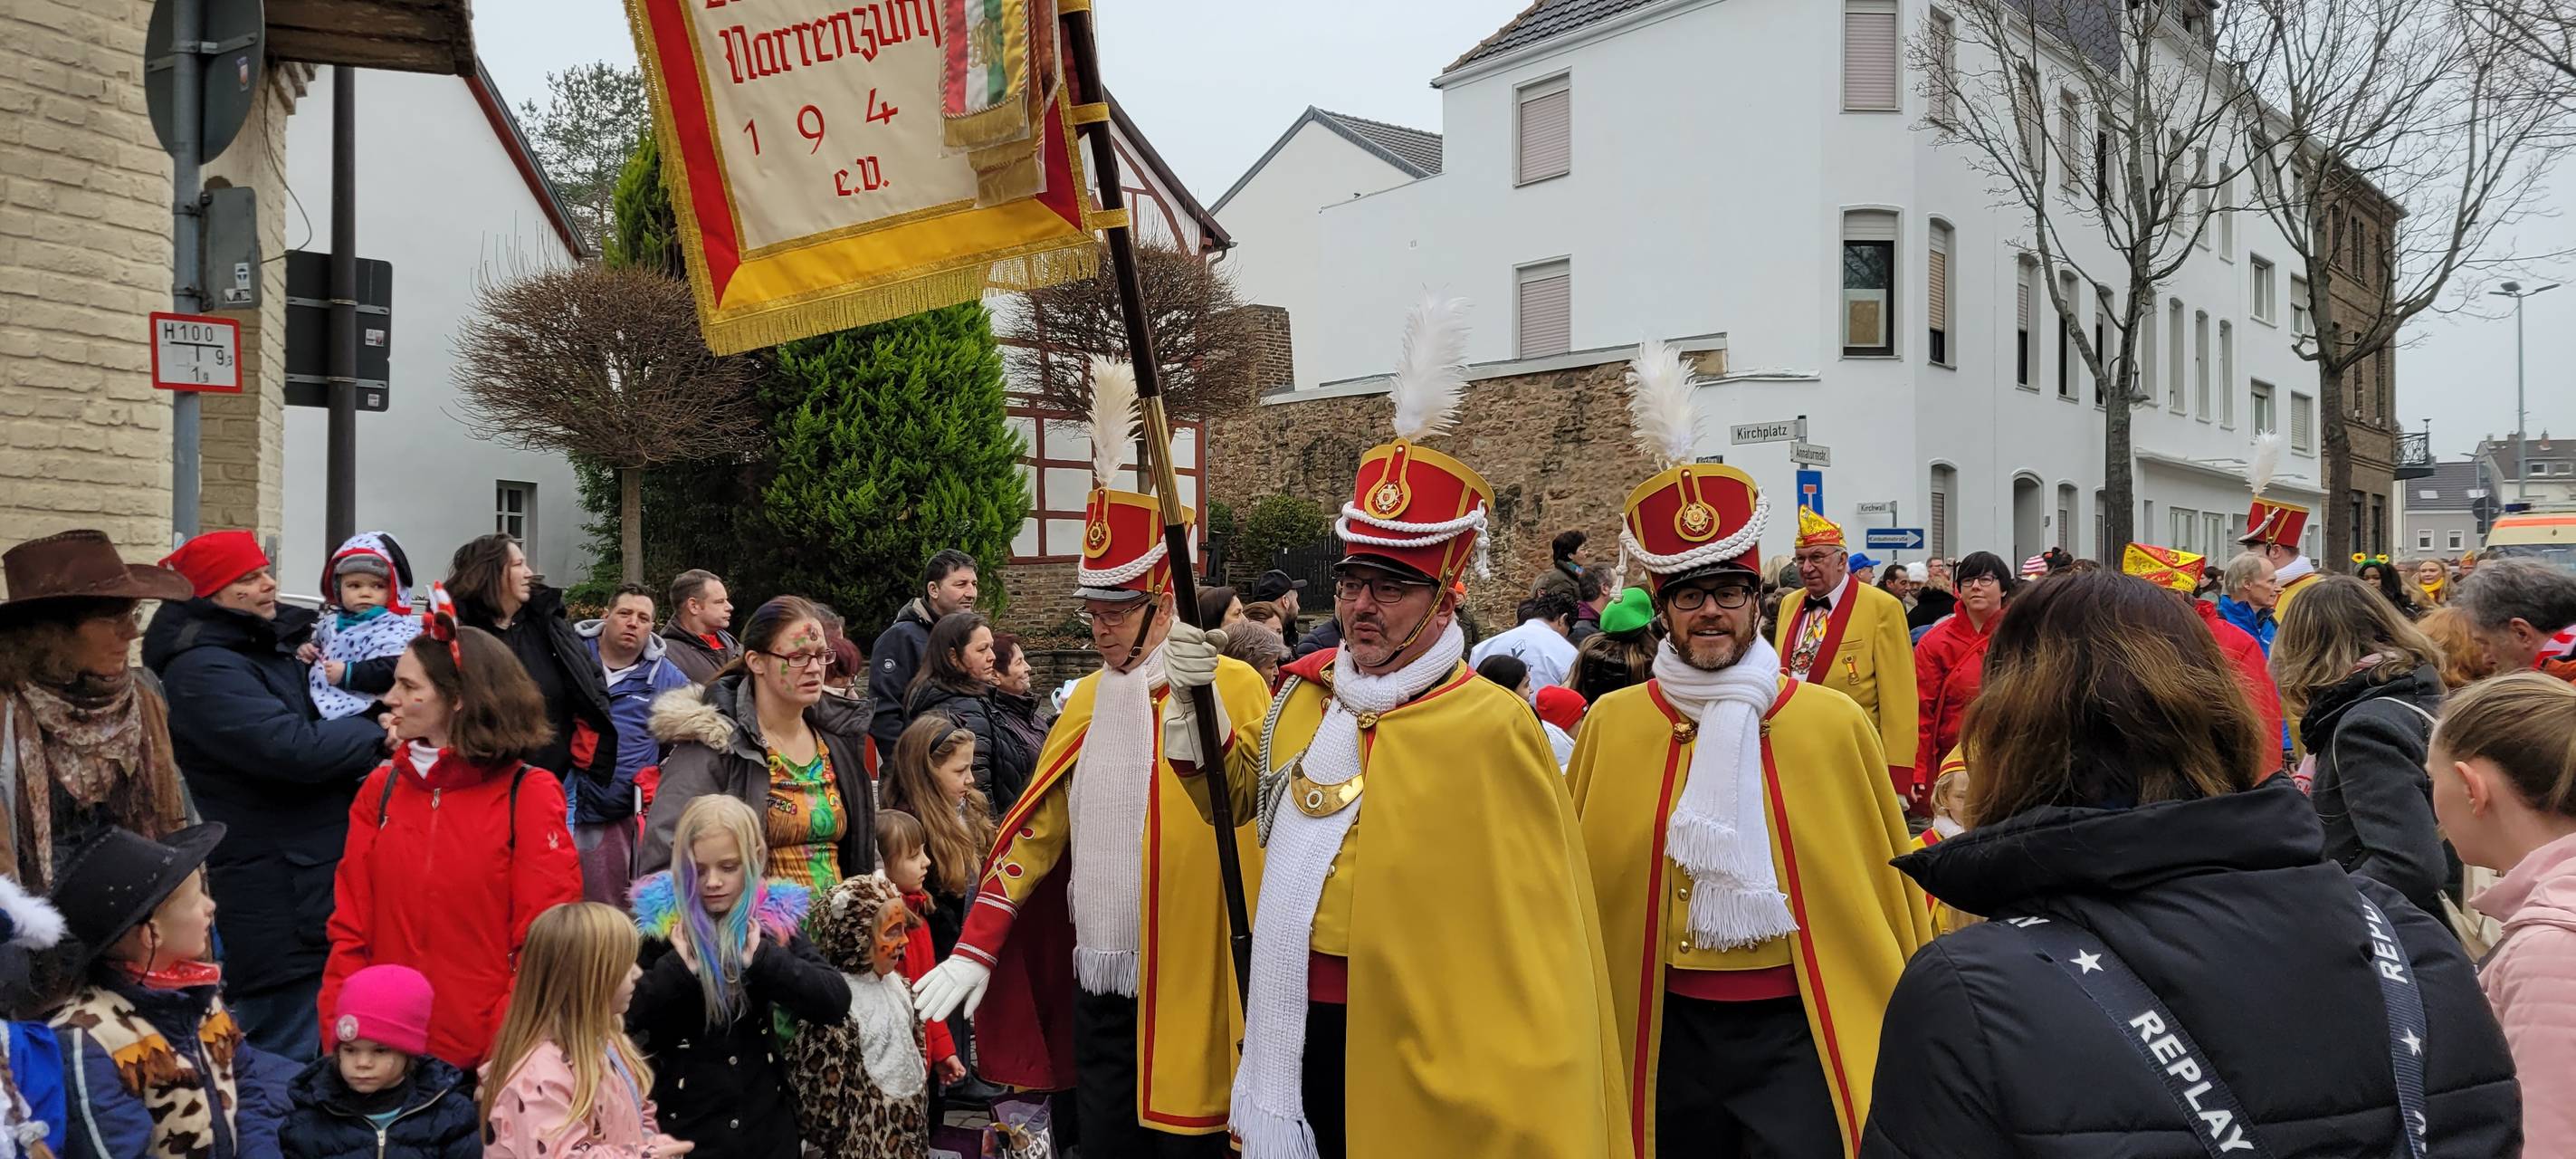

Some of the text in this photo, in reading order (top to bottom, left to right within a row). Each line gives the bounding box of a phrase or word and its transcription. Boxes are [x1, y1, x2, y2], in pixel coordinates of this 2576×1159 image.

[1737, 426, 1788, 440] Kirchplatz
[1861, 503, 1886, 512] Kirchwall
[2362, 905, 2409, 984] REPL
[2129, 1010, 2255, 1153] REPLAY
